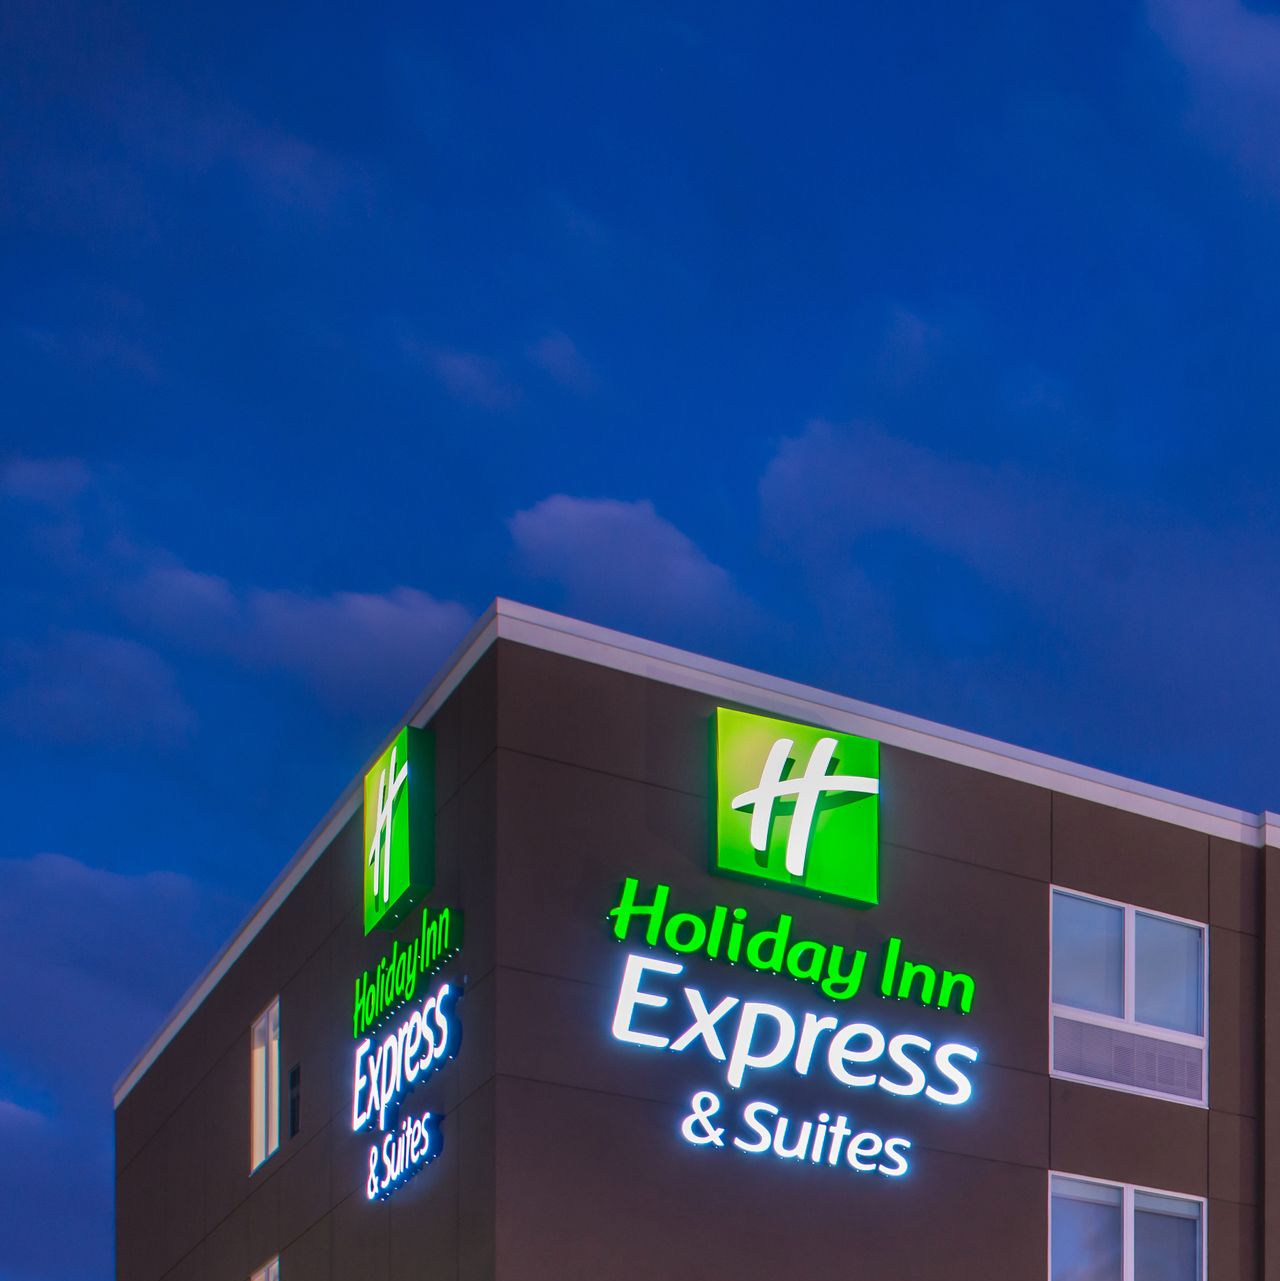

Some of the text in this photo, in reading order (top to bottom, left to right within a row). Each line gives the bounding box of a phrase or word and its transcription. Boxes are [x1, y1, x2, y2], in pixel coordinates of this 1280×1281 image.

[352, 906, 450, 1039] Holiday Inn
[610, 876, 976, 1014] Holiday Inn
[352, 982, 450, 1132] Express
[611, 953, 979, 1106] Express
[366, 1110, 431, 1200] & Suites
[680, 1090, 912, 1177] & Suites
